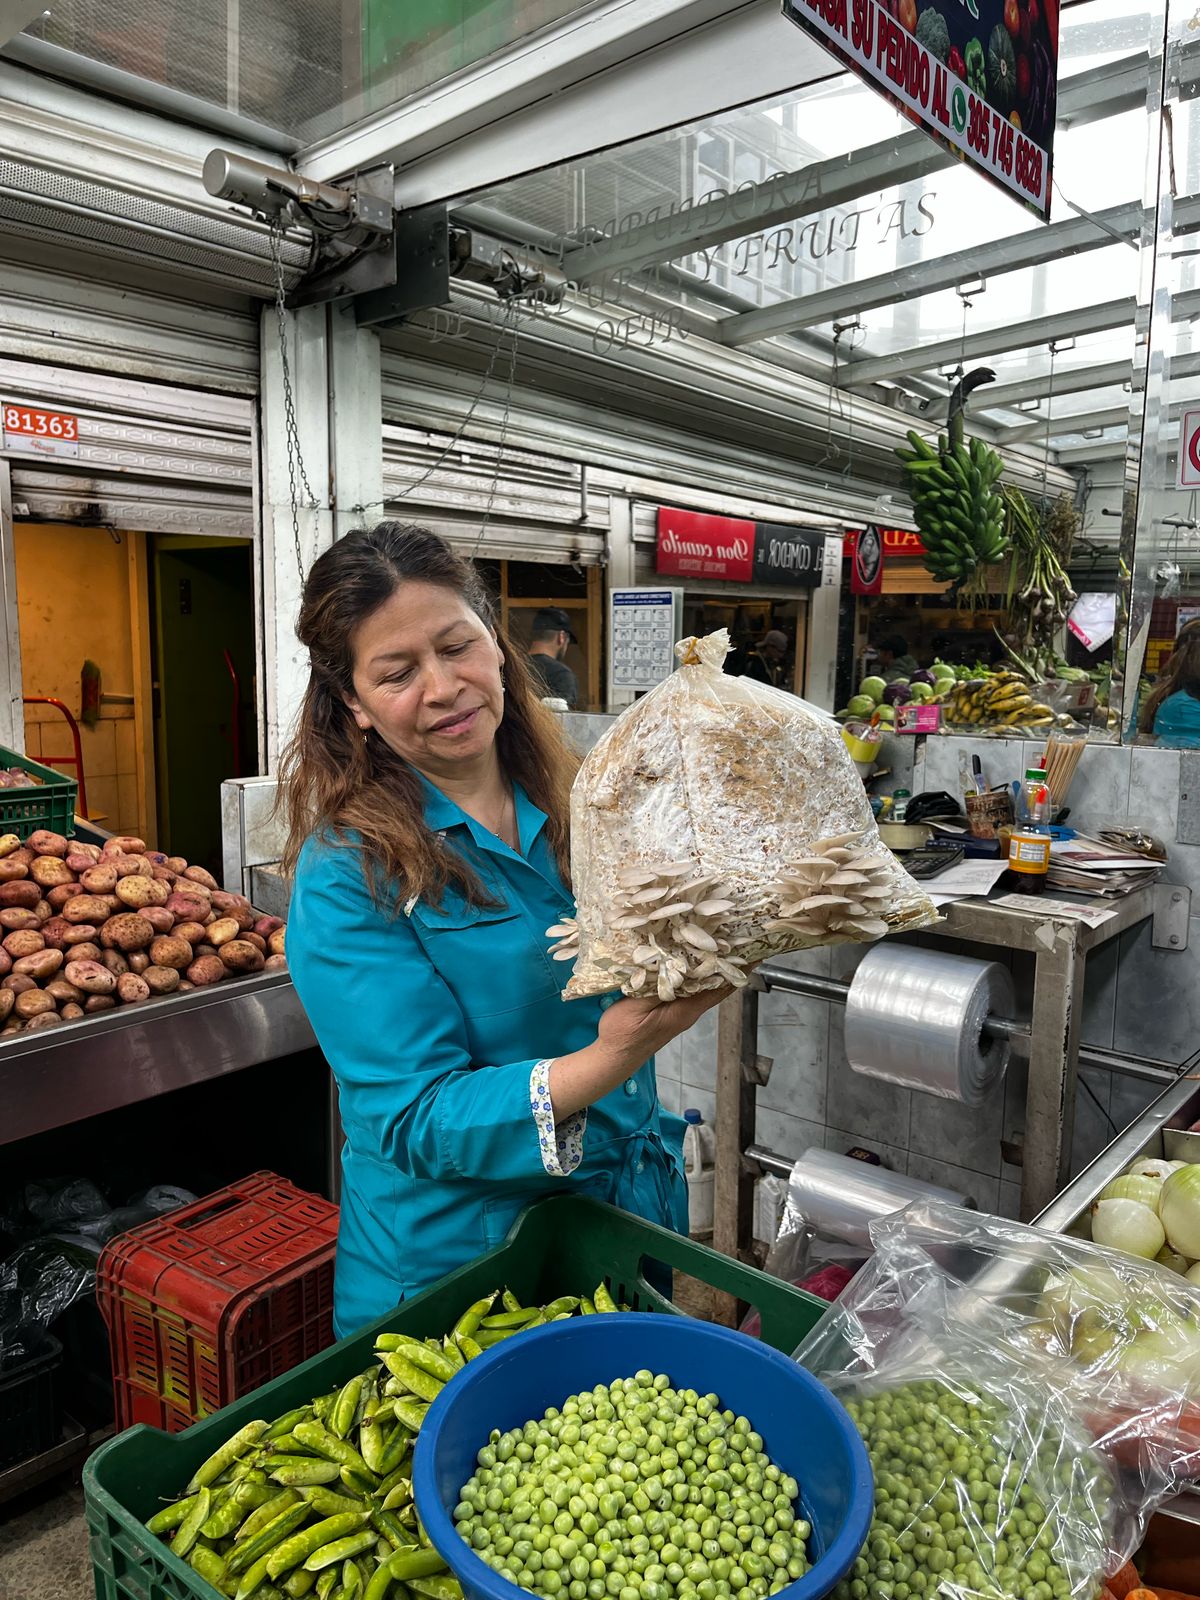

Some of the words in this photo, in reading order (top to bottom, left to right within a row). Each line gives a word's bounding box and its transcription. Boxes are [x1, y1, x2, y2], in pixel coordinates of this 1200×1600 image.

[852, 0, 874, 60] SU
[876, 10, 929, 109] PEDIDO
[932, 64, 951, 129] AL
[967, 94, 991, 159] 305
[992, 117, 1014, 176] 745
[698, 246, 726, 283] Y
[734, 192, 938, 277] FRUTAS
[592, 307, 690, 355] OFIR
[6, 409, 75, 438] 81363
